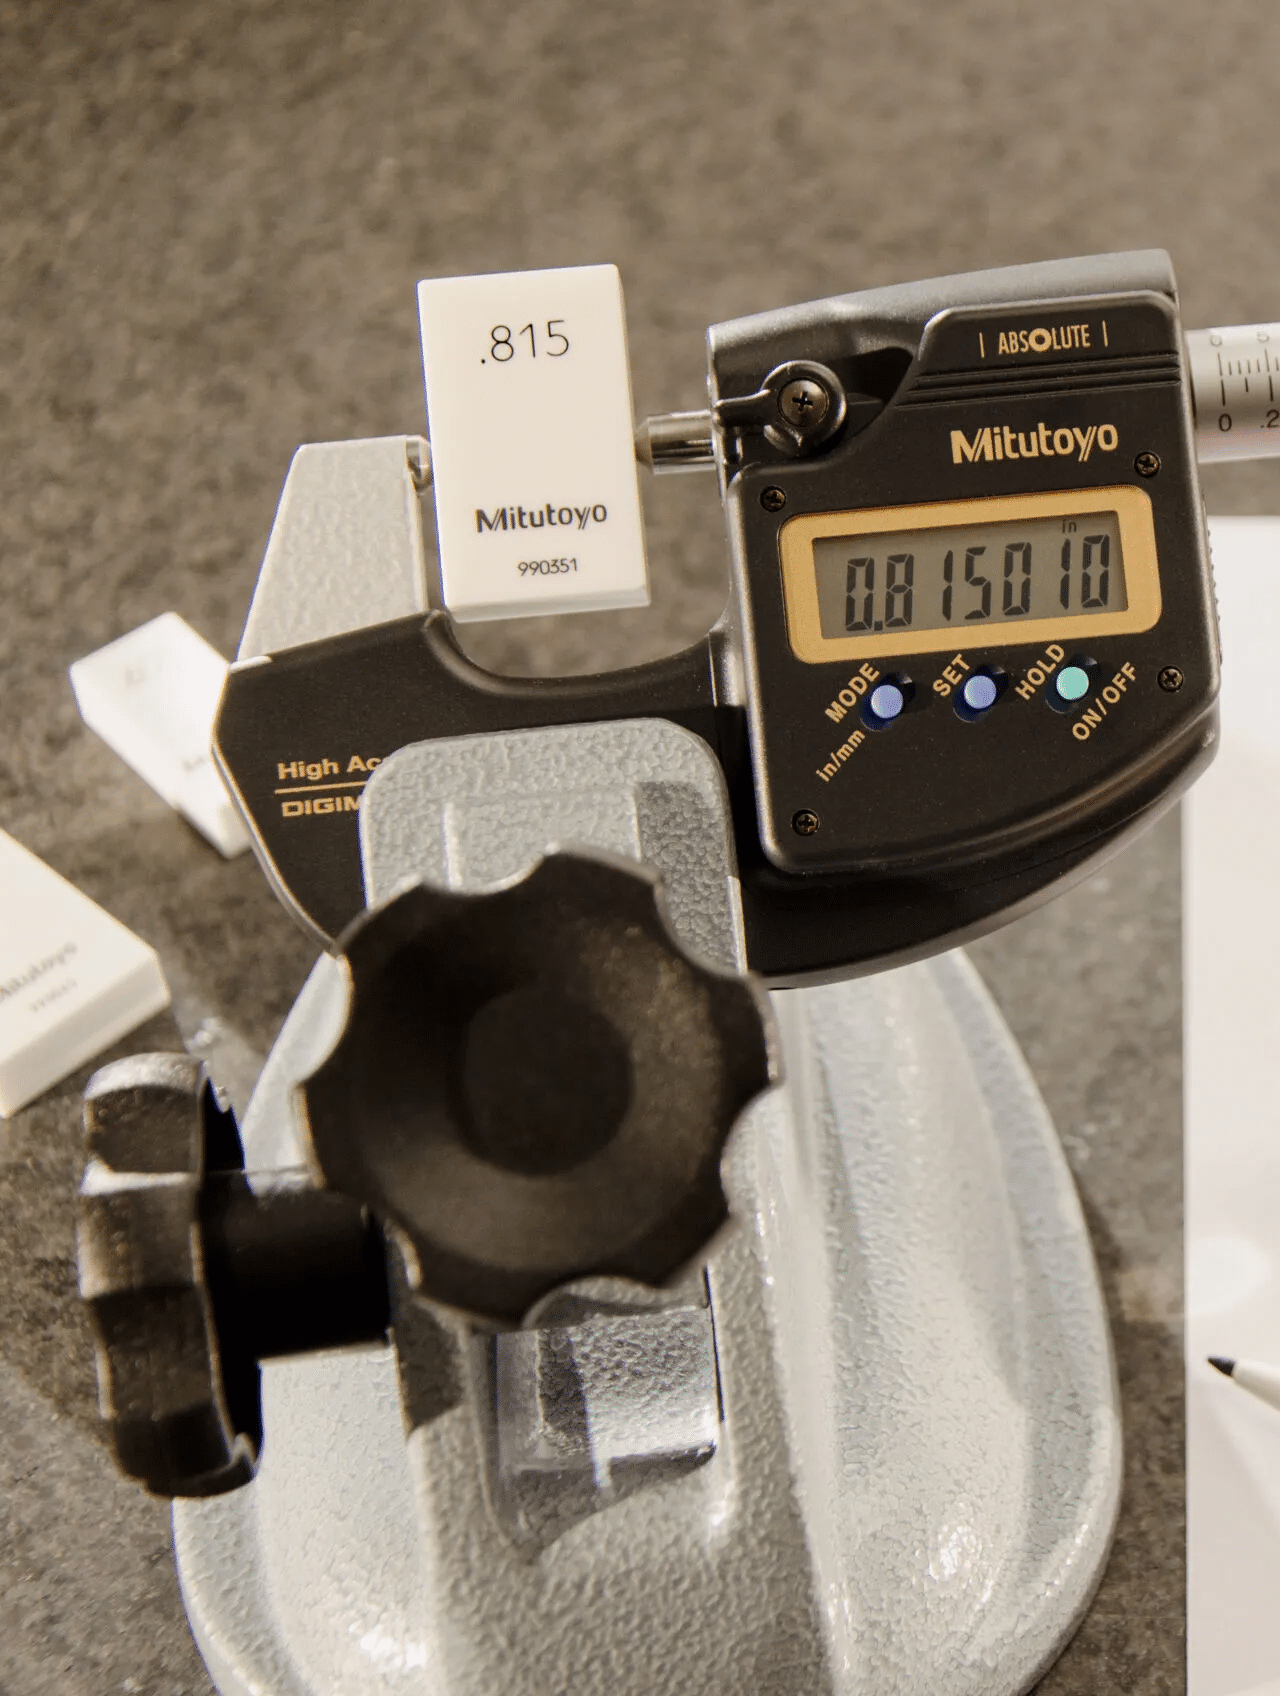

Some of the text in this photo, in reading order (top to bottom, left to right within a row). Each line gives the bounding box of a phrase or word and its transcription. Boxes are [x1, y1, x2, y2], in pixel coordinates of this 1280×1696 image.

[481, 319, 569, 364] .815
[998, 324, 1091, 355] ABSOLUTE
[950, 423, 1118, 464] Mitutoyo
[1218, 413, 1232, 432] 0
[1261, 410, 1279, 428] .2
[475, 504, 607, 533] Mitutoyo
[518, 558, 577, 577] 990351
[845, 533, 1110, 632] 0.815010
[824, 662, 880, 723] MODE
[932, 653, 972, 698] SET
[1015, 643, 1066, 700] HOLD
[1071, 661, 1137, 742] ON/OFF
[277, 758, 339, 781] High
[815, 729, 865, 783] in/mm
